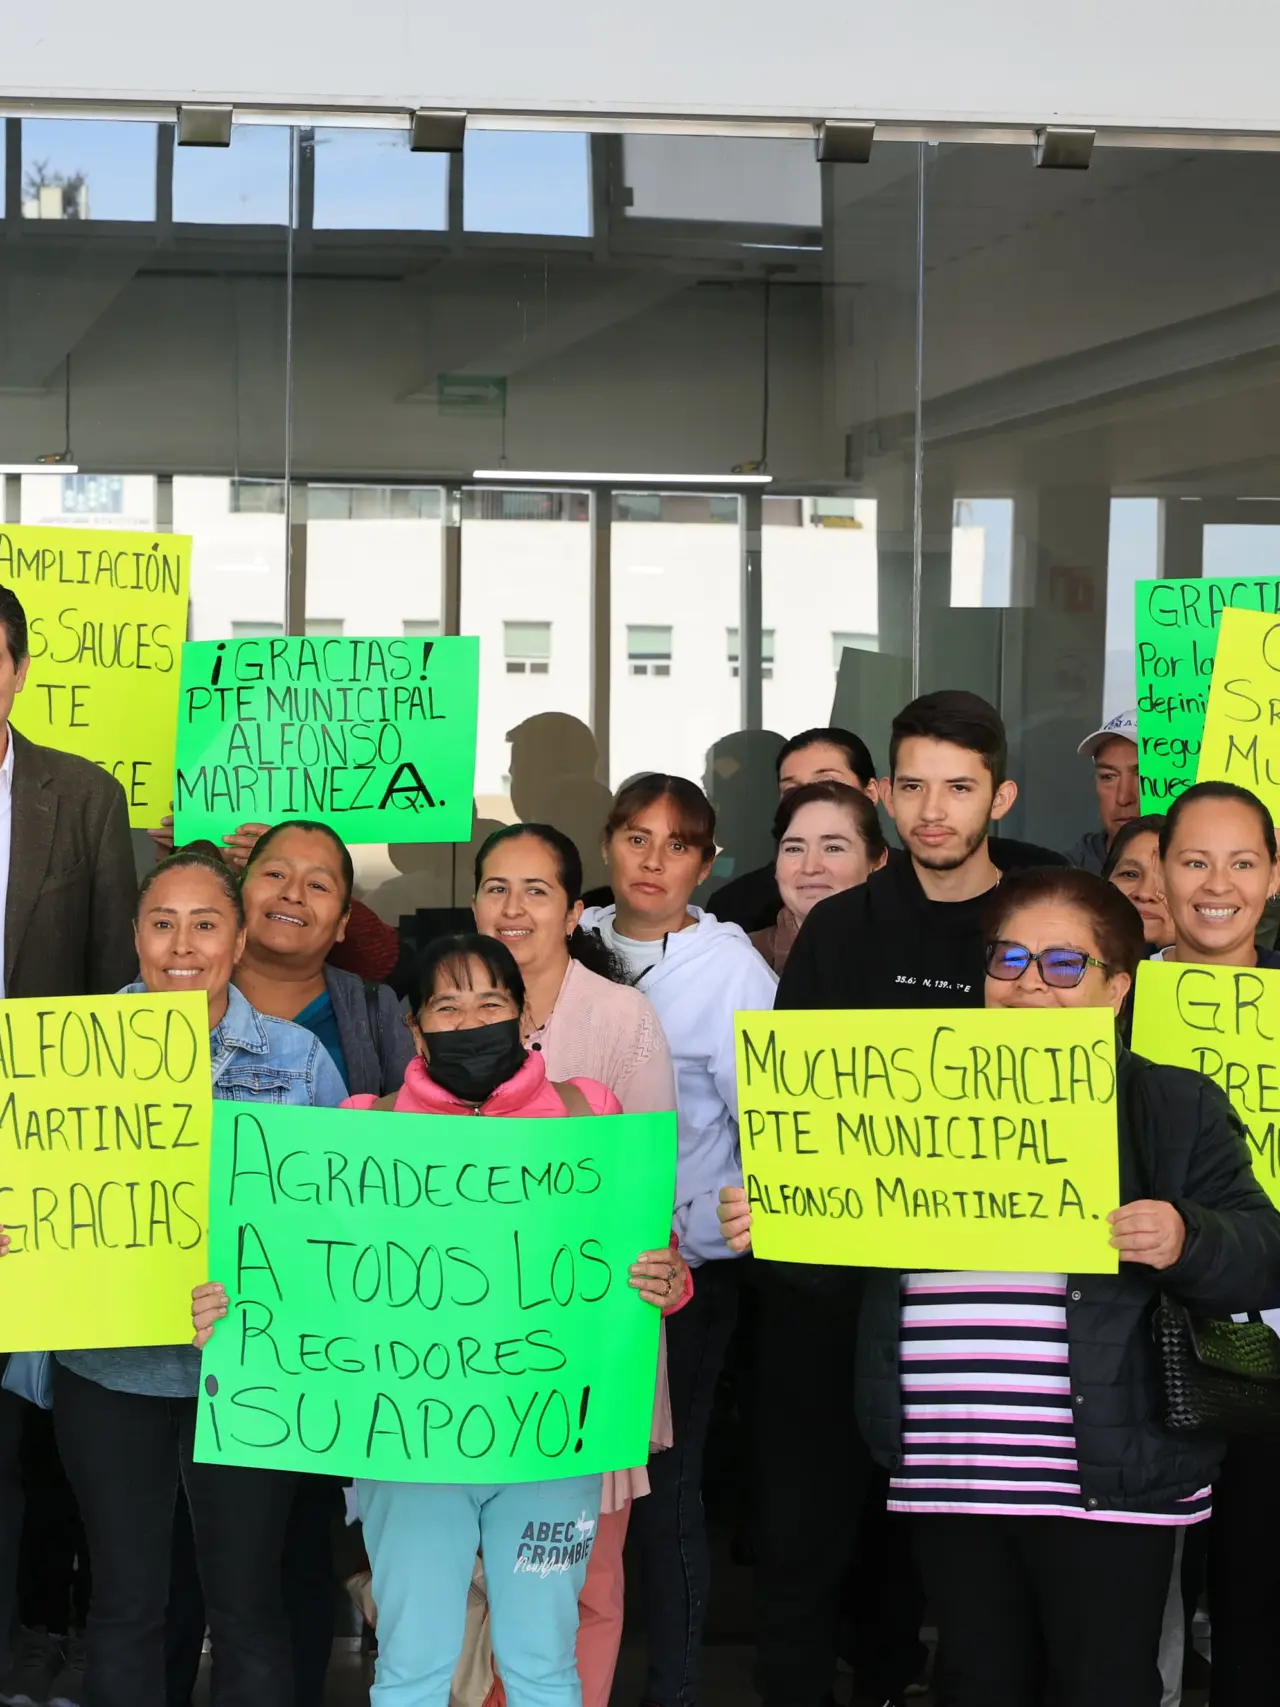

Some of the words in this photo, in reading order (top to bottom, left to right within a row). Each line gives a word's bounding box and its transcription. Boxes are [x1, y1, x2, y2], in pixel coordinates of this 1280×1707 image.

[1149, 581, 1280, 628] GRACI
[50, 608, 173, 672] SAUCES
[211, 639, 434, 685] ¡GRACIAS!
[1138, 642, 1184, 678] Por
[36, 684, 91, 727] TE
[186, 686, 256, 723] PTE
[266, 686, 446, 723] MUNICIPAL
[227, 722, 402, 767] ALFONSO
[176, 765, 377, 813] MARTINEZ
[742, 1029, 921, 1103] MUCHAS
[930, 1026, 1116, 1105] GRACIAS
[229, 1112, 602, 1208] AGRADECEMOS
[743, 1109, 818, 1154] PTE
[836, 1112, 1068, 1165] MUNICIPAL
[746, 1174, 863, 1219] ALFONSO
[875, 1176, 1049, 1219] MARTINEZ
[1058, 1178, 1100, 1220] A.
[237, 1222, 282, 1301] A
[306, 1238, 490, 1310] TODOS
[514, 1230, 612, 1310] LOS
[235, 1300, 567, 1380] REGIDORES
[205, 1373, 342, 1453] ¡SU
[366, 1385, 591, 1460] APOYO!
[517, 1537, 593, 1565] CROMBIE
